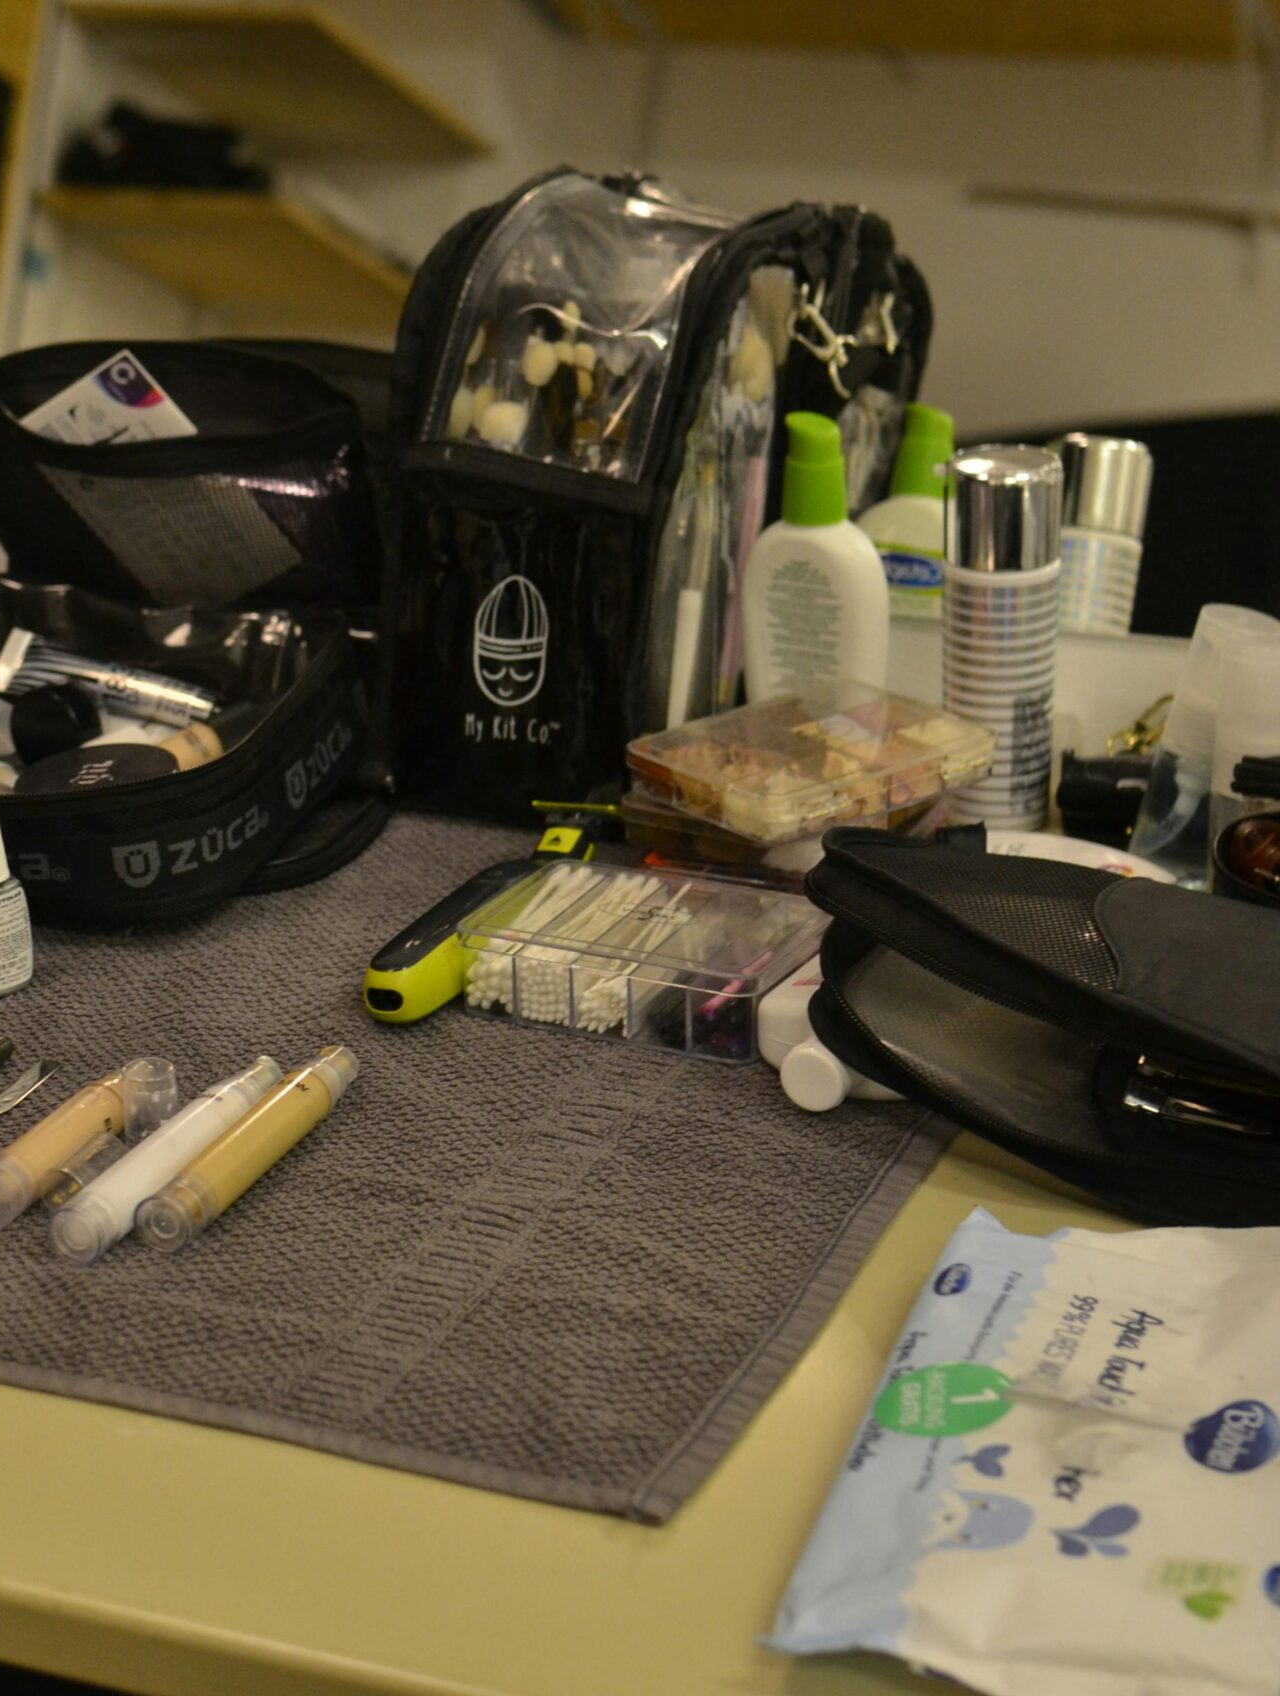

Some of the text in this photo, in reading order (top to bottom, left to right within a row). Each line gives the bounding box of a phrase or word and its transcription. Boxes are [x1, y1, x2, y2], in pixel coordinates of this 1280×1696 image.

[465, 713, 483, 743] My
[493, 716, 517, 740] Kit
[1060, 1294, 1099, 1325] 99%
[1111, 1308, 1164, 1350] Aqua
[951, 1387, 1000, 1405] 1
